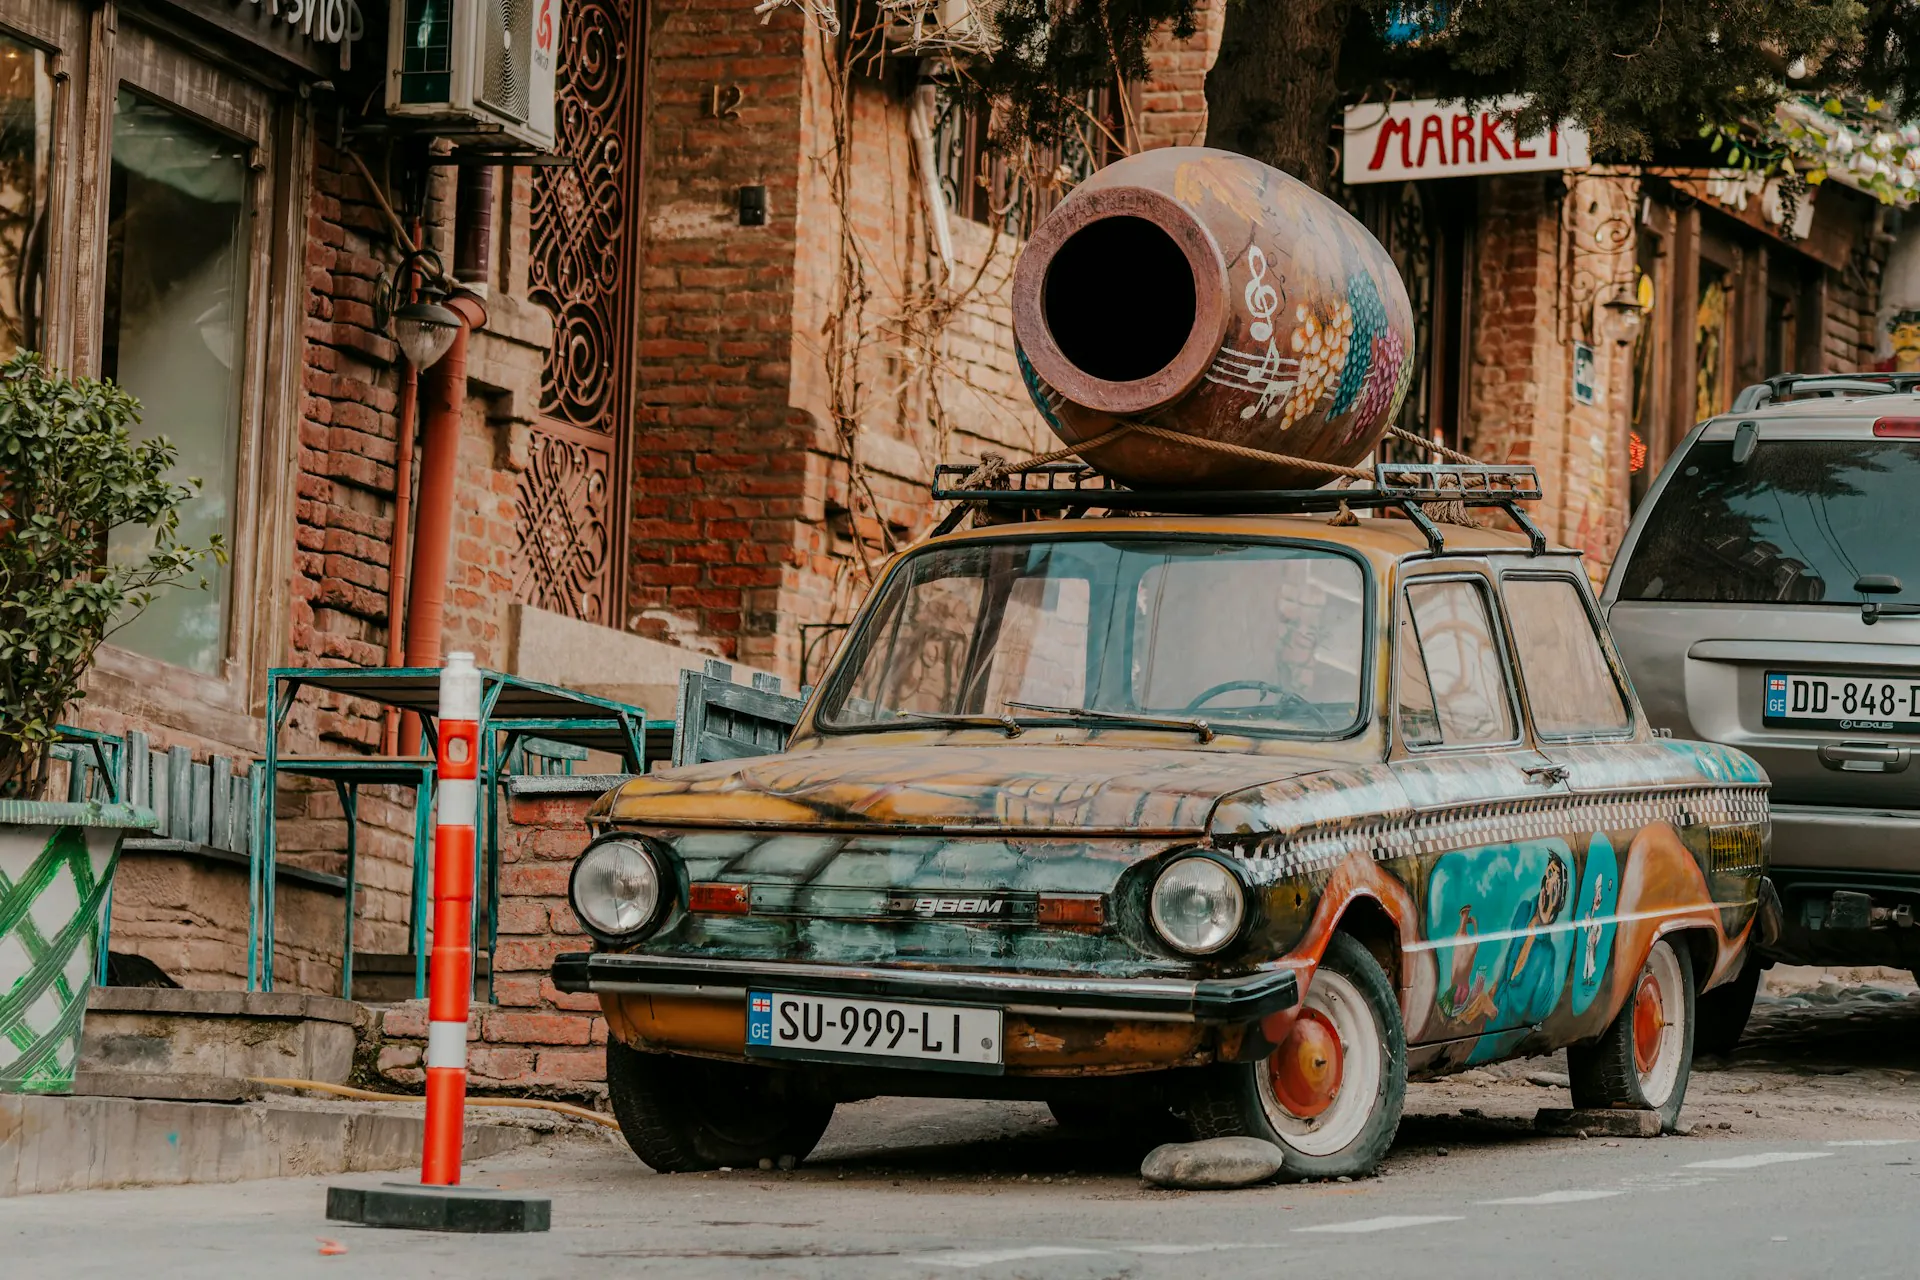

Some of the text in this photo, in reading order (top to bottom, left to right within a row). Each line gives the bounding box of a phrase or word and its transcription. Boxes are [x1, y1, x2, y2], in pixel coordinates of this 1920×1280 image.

[713, 82, 744, 118] 12
[1769, 698, 1785, 712] GE
[1853, 720, 1894, 729] LEXUS
[914, 898, 1003, 917] 968M
[751, 1001, 961, 1054] GE SU-999-LI
